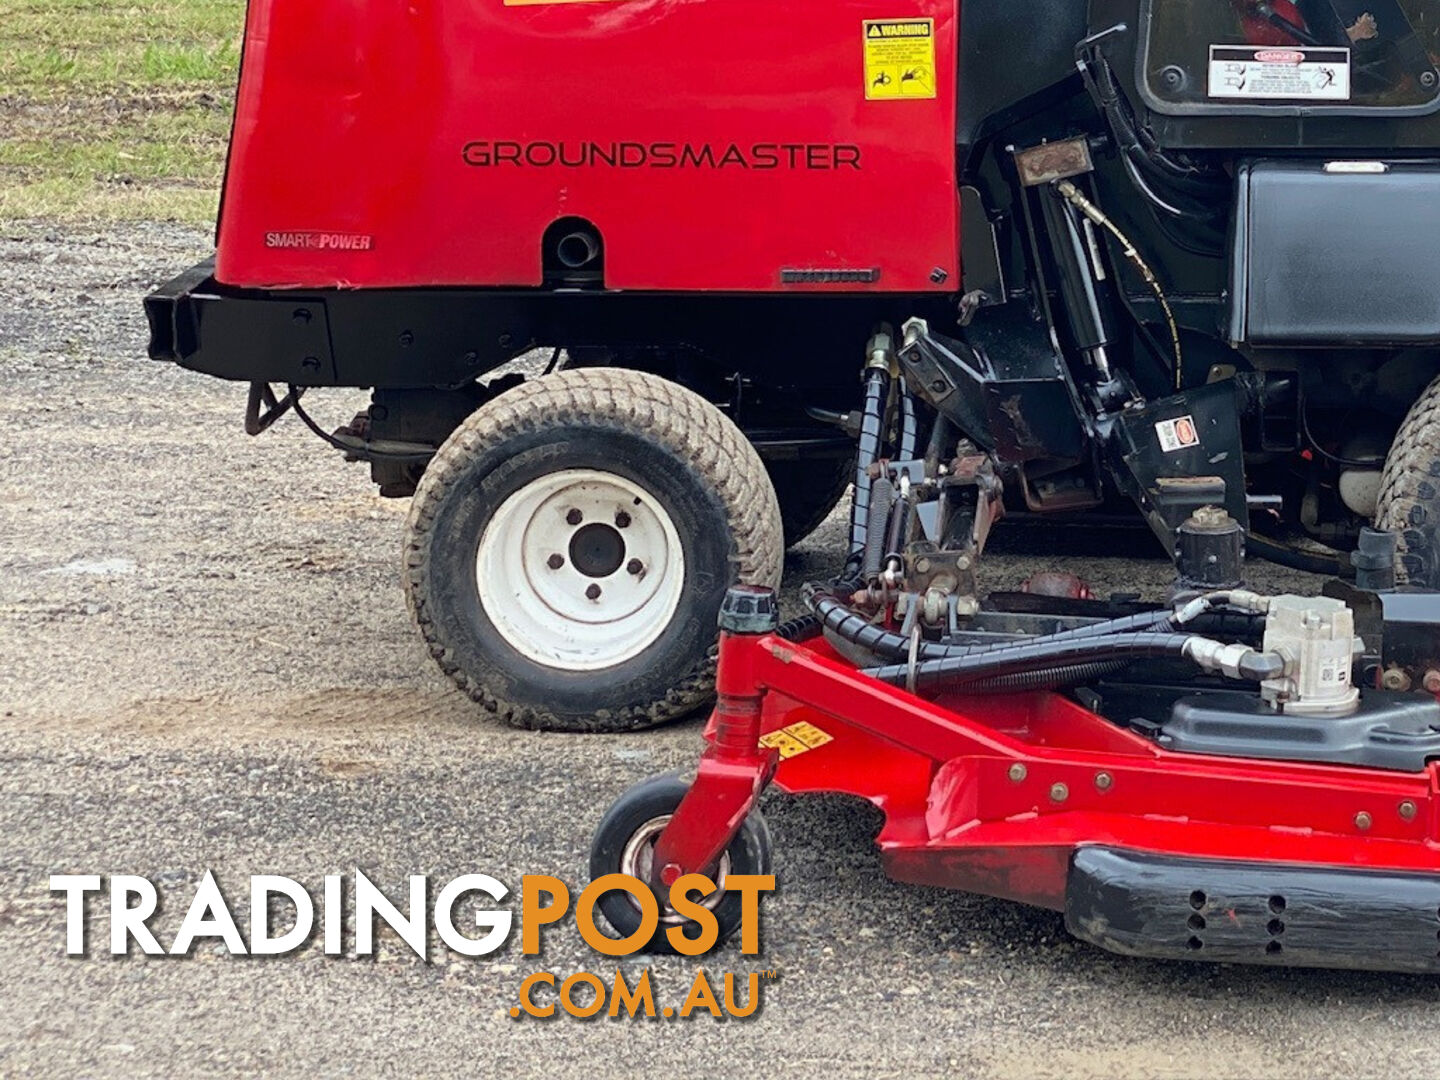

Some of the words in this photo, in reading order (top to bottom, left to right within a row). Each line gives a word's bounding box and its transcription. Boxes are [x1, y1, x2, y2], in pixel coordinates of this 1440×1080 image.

[880, 23, 930, 36] WARNING
[462, 140, 862, 169] GROUNDSMASTER
[265, 232, 312, 248] SMART
[318, 233, 372, 250] POWER
